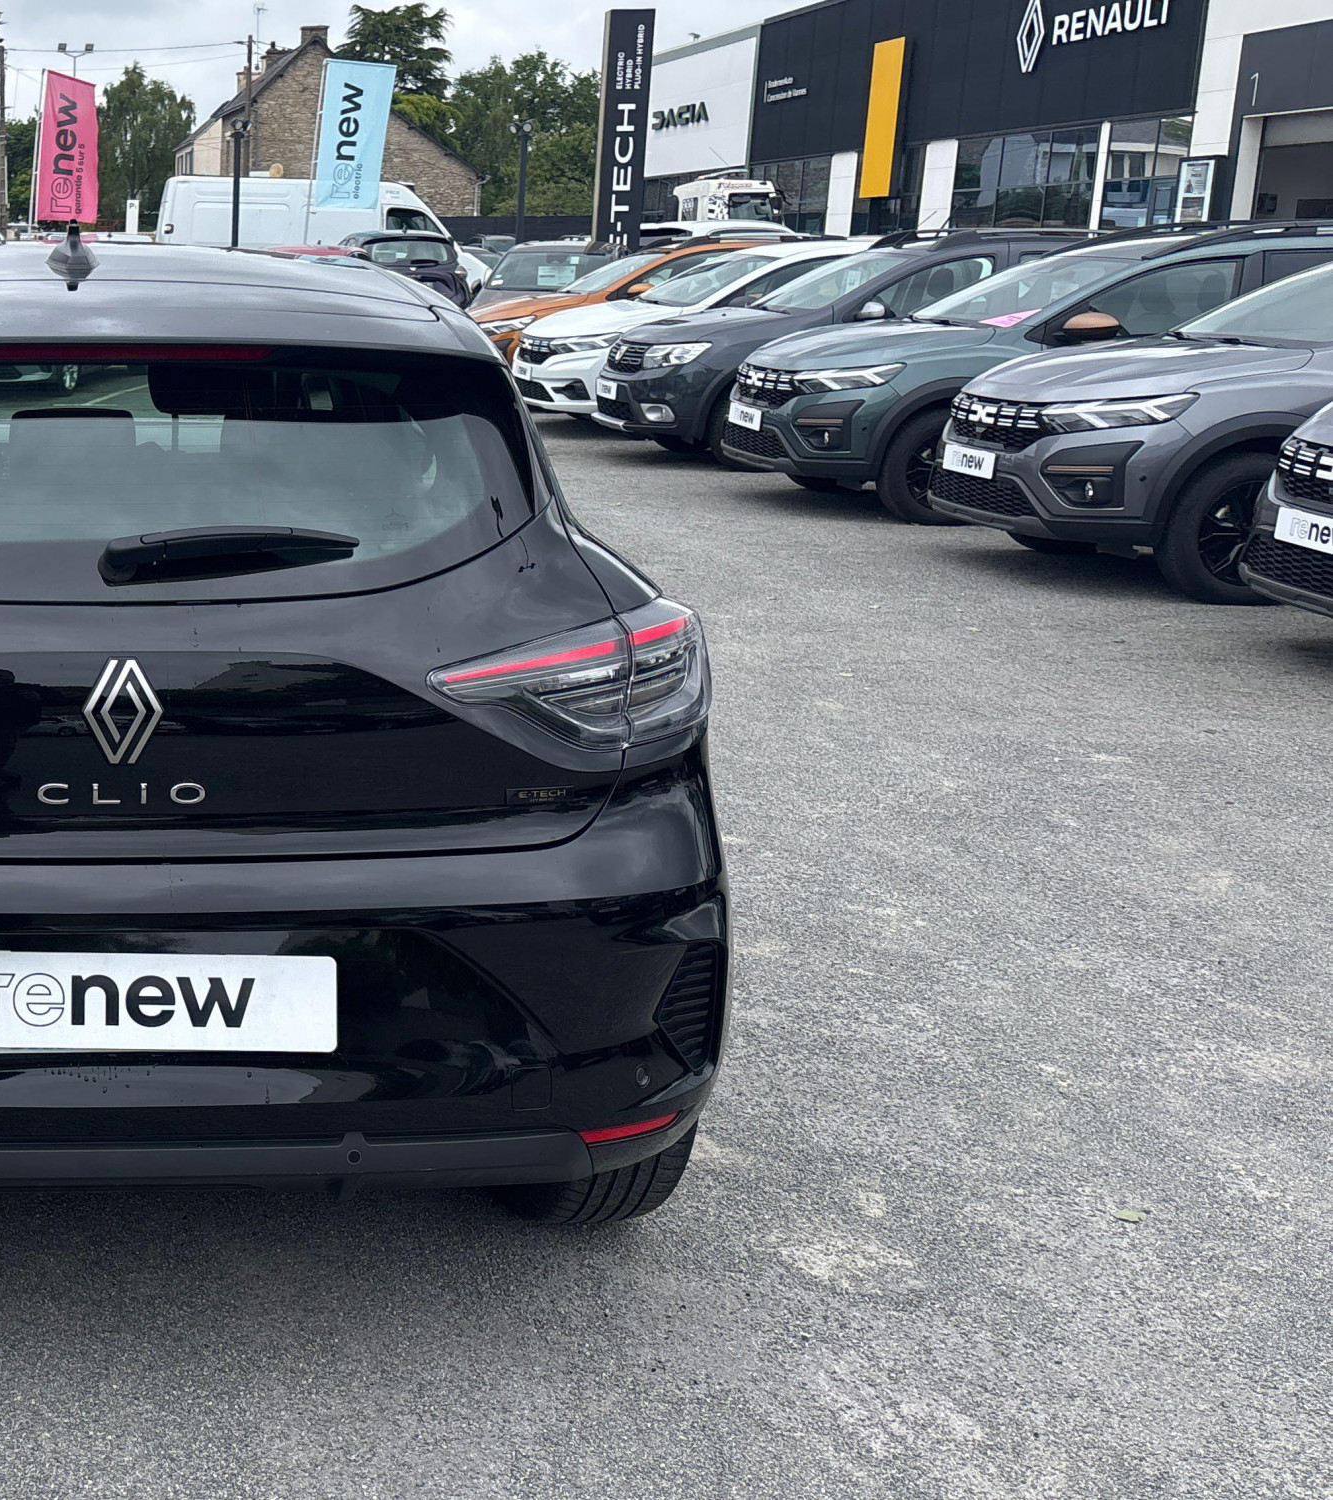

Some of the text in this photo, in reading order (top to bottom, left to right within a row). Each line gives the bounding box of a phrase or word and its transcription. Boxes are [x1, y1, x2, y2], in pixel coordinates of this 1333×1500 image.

[1052, 0, 1170, 45] RENAULT
[616, 51, 625, 90] ELECTRIC
[634, 24, 645, 90] PLUG-IN HYBRID
[625, 59, 634, 90] HYBRID
[1250, 72, 1259, 106] 1
[652, 101, 709, 131] DACIA
[50, 92, 78, 214] renew
[330, 82, 364, 199] renew
[352, 163, 363, 200] electric
[950, 449, 986, 471] renew
[1289, 516, 1333, 547] rene
[37, 782, 206, 805] CLIO
[518, 789, 566, 799] E-TECH
